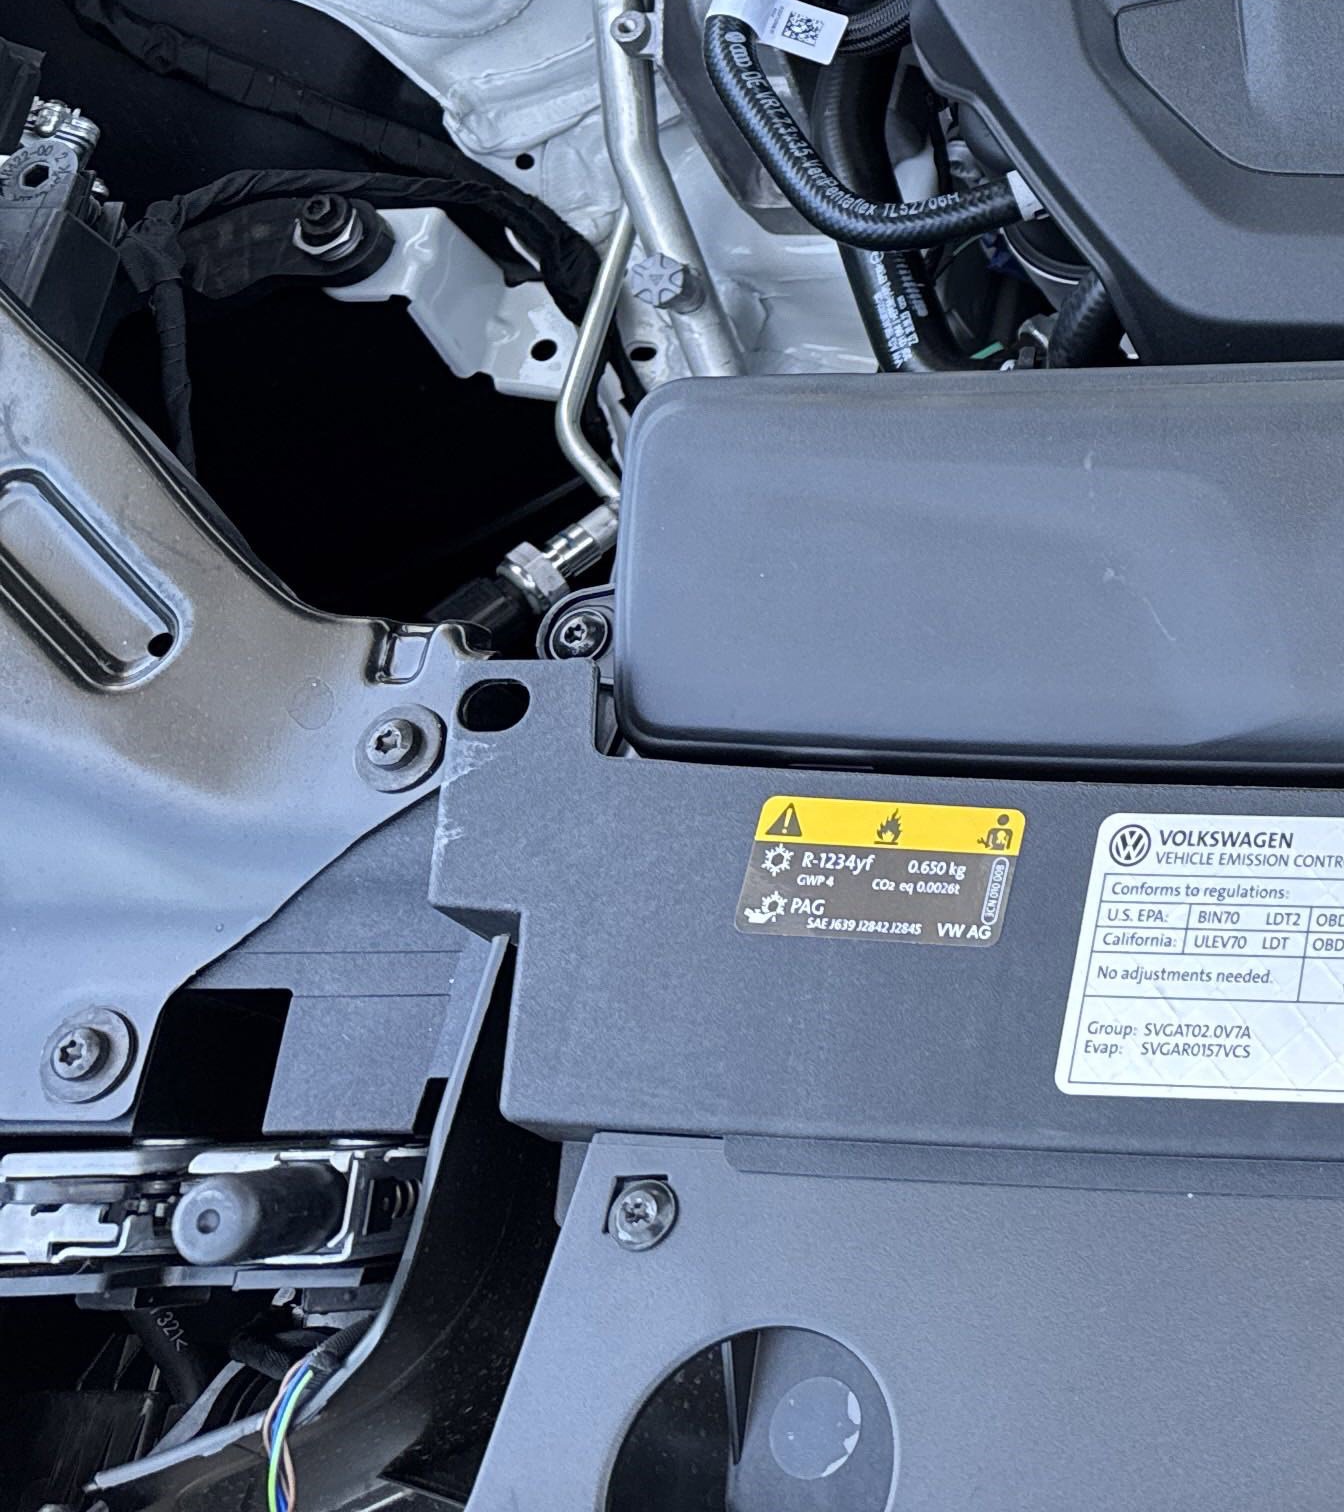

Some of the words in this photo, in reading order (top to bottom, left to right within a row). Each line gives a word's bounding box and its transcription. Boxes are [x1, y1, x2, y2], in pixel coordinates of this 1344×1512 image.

[1159, 829, 1293, 848] VOLKSWAGEN
[801, 851, 875, 874] R-1234yf
[1155, 850, 1214, 865] VEHICLE
[1217, 852, 1289, 867] EMISSION
[907, 859, 947, 875] 0.650
[948, 860, 966, 880] kg
[898, 881, 914, 895] eq
[1110, 881, 1181, 898] Conforms
[1184, 883, 1200, 897] to
[1202, 883, 1289, 902] regulations:
[789, 897, 825, 915] PAG
[805, 916, 829, 929] SAE
[1136, 908, 1168, 922] EPA:
[1197, 909, 1240, 925] BIN70
[1265, 911, 1301, 926] LDT2
[936, 922, 966, 938] VW
[965, 922, 993, 939] AG
[1102, 931, 1176, 947] California:
[1193, 934, 1247, 949] ULEV70
[1261, 935, 1290, 950] LDT
[1096, 965, 1118, 980] No
[1120, 965, 1212, 984] adjustments
[1215, 968, 1272, 984] needed.
[1086, 1020, 1137, 1039] Group:
[1083, 1040, 1122, 1058] Evap:
